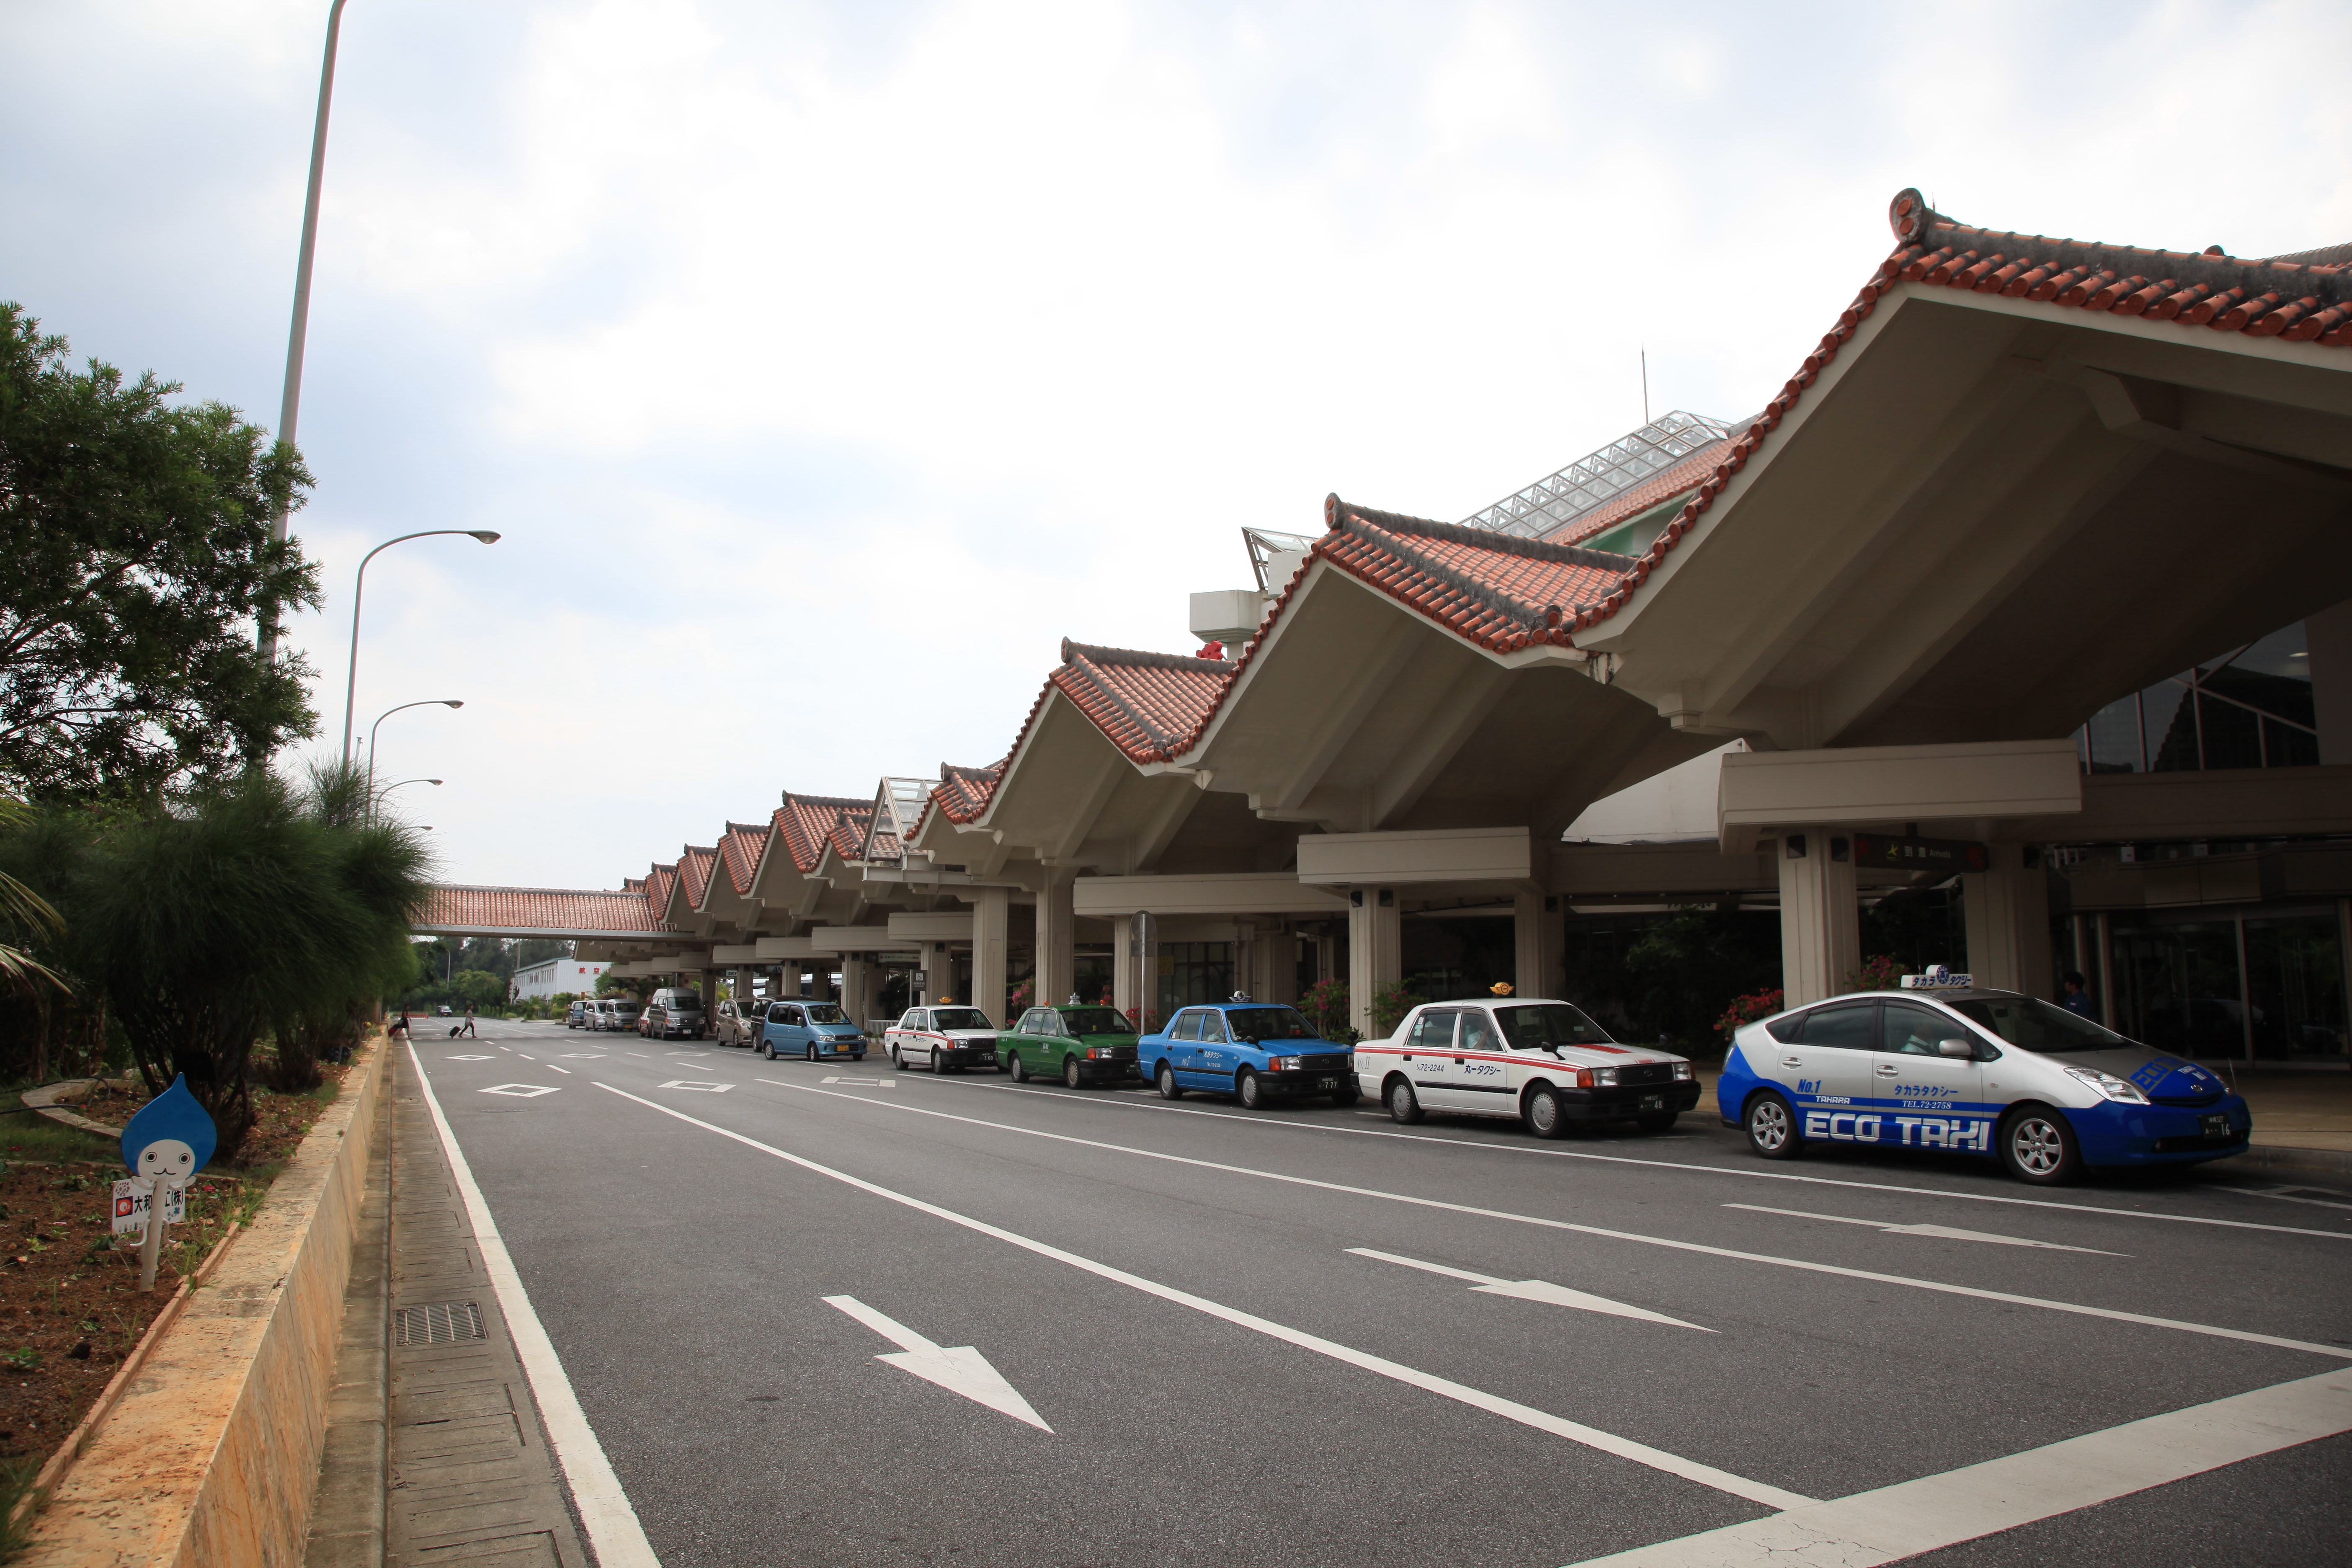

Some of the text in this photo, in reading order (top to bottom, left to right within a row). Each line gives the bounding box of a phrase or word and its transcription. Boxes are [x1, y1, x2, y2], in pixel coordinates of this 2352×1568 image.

[1904, 846, 1951, 858] 到着 Arrivals
[1912, 975, 1972, 987] タカラ タクシー
[1421, 1063, 1444, 1072] 72-2244
[2130, 1062, 2169, 1091] ECO
[1797, 1079, 1821, 1093] No.1
[1894, 1084, 1958, 1097] タカラタクシー
[1816, 1095, 1851, 1104] TAKARA
[1805, 1111, 1991, 1151] ECO TAXI
